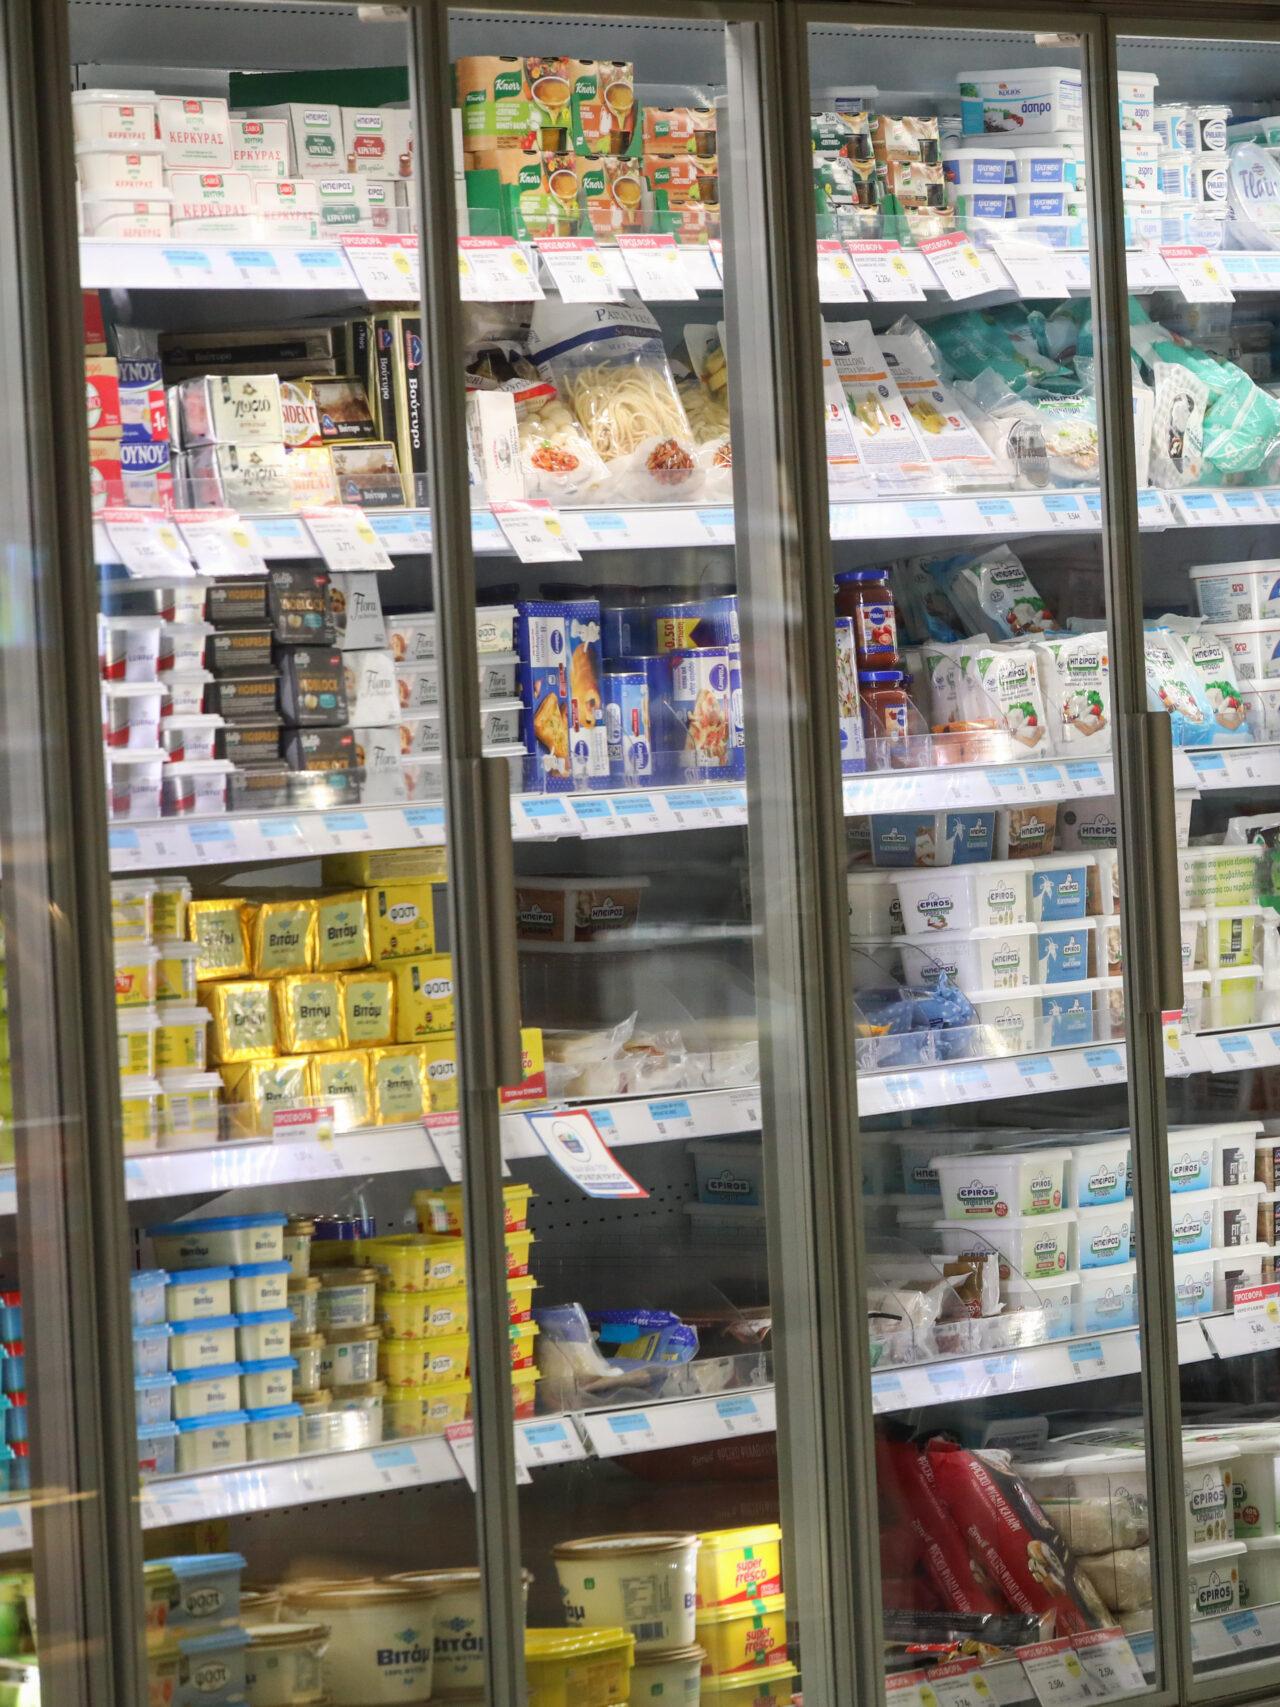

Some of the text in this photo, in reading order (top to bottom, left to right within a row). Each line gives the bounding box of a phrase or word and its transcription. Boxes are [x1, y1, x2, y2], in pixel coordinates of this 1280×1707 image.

[496, 79, 521, 91] Knorr
[575, 82, 596, 94] Knorr
[1021, 100, 1051, 116] άσπρο
[169, 131, 224, 145] ΚΕΡΚΥΡΑΣ
[234, 150, 281, 161] ΕΡΚΥΡΑΣ
[519, 172, 541, 183] Knorr
[583, 177, 604, 189] Knorr
[408, 378, 421, 449] Βούτυρο
[121, 445, 165, 465] ΟΥΝΟΥ
[1082, 826, 1116, 837] ΗΠΕΙΡΟ
[920, 901, 951, 909] EPIROS
[269, 931, 299, 946] Βιτάμ
[327, 924, 357, 940] Βιτάμ
[353, 1002, 382, 1018] Βιτάμ
[1173, 1164, 1198, 1174] EPIROS
[1090, 1176, 1116, 1187] ΗΠΕΙΡΟΣ
[960, 1188, 995, 1197] EPIROS
[1093, 1237, 1119, 1248] ΗΠΕΙΡΟΣ
[1193, 1489, 1225, 1506] EPIROS
[736, 1560, 763, 1574] super
[735, 1570, 767, 1587] fresco
[1200, 1587, 1231, 1601] EPIROS
[745, 1627, 771, 1642] super
[745, 1638, 775, 1655] fresco
[377, 1643, 430, 1667] Βιτάμ
